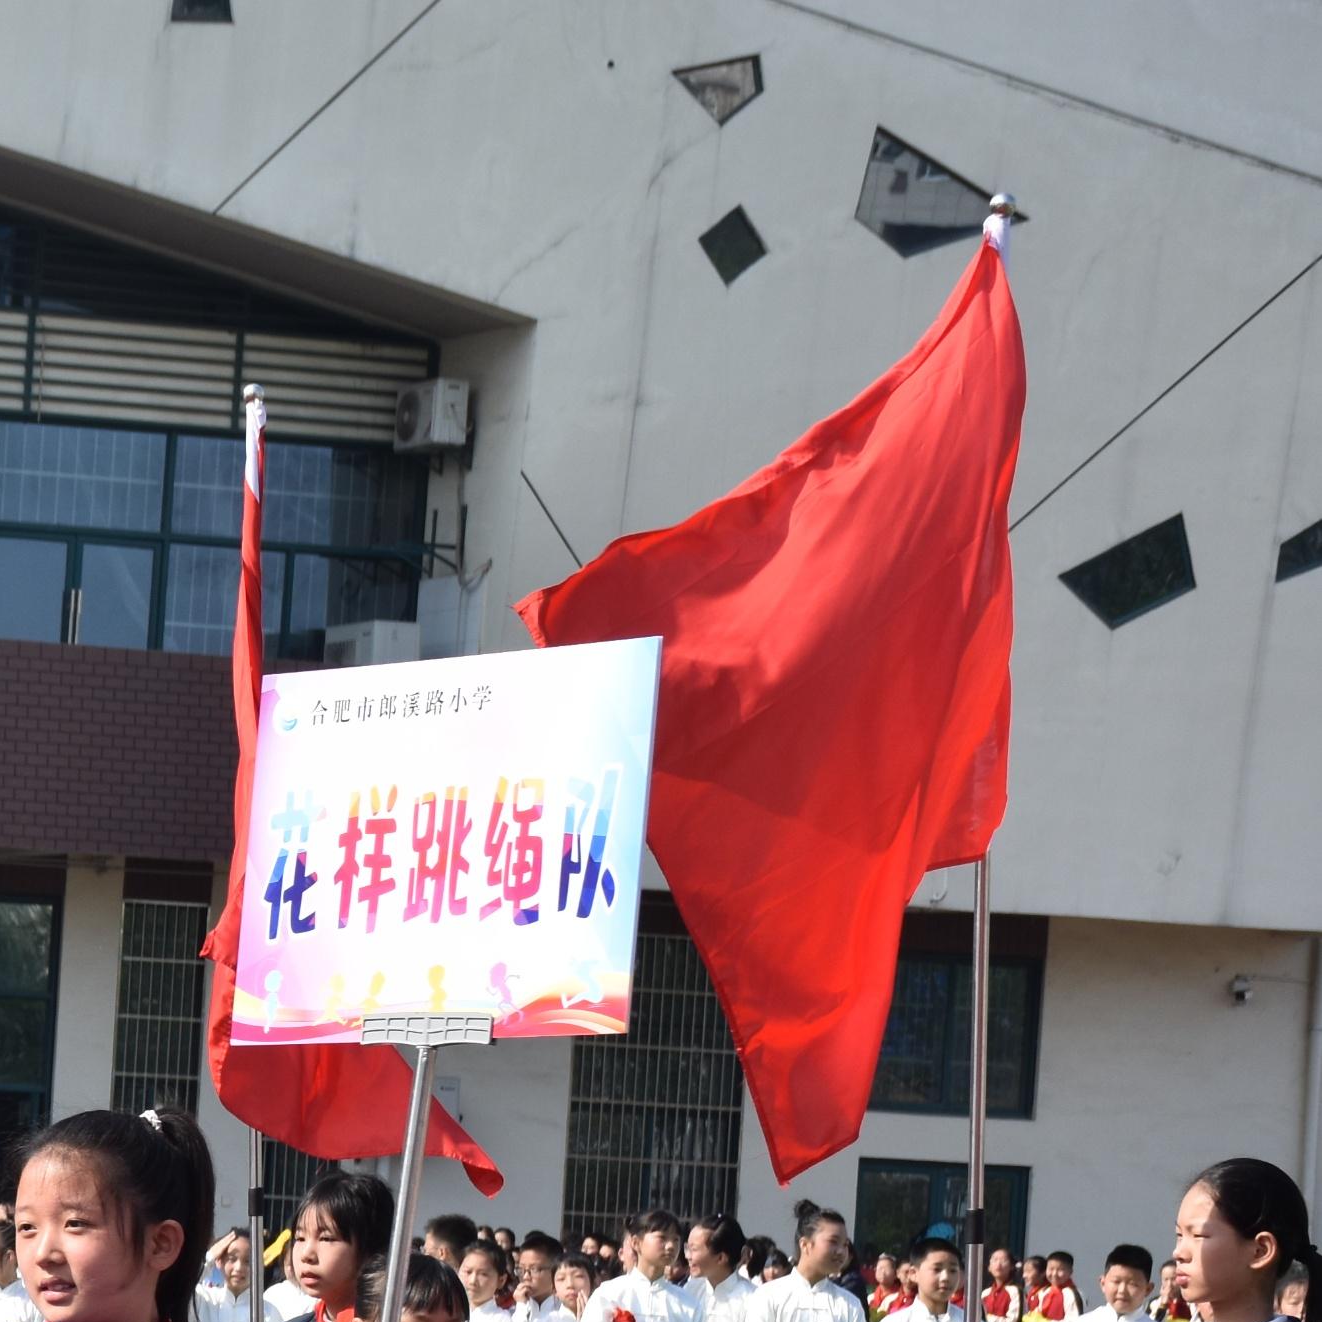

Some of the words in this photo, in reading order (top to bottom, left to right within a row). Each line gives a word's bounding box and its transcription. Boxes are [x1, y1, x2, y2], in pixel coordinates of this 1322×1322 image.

[311, 685, 493, 726] 合肥市郎溪路小学
[262, 767, 621, 941] 花样跳绳队
